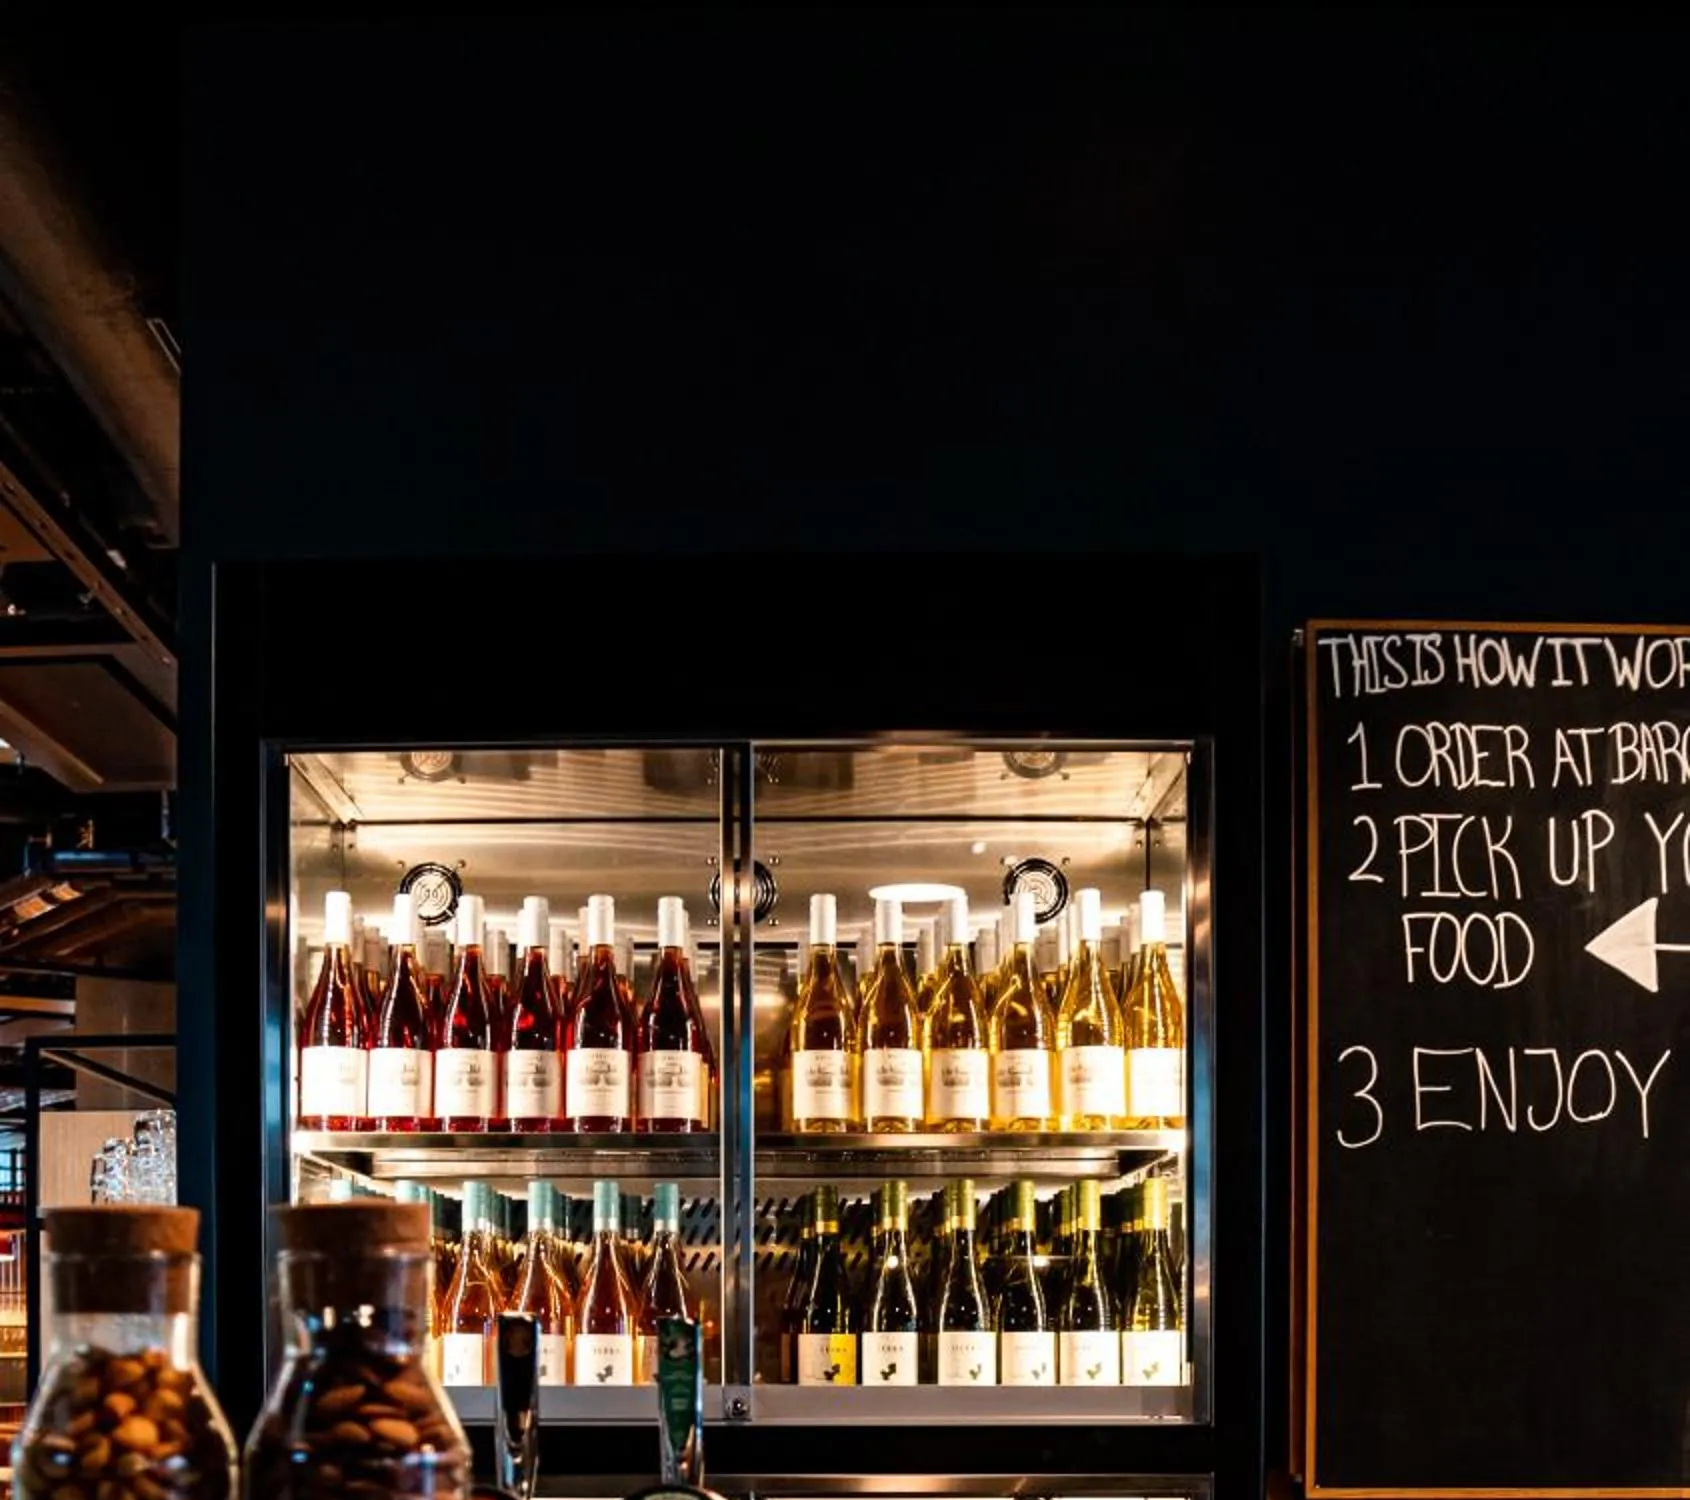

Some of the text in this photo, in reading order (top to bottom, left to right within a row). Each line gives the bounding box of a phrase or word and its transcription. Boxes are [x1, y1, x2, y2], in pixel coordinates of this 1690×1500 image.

[1317, 633, 1409, 698] THIS
[1405, 632, 1446, 687] IS
[1453, 633, 1545, 689] HOW
[1545, 637, 1603, 687] IT
[1347, 720, 1690, 791] 1 ORDER AT BAR
[1347, 809, 1690, 901] 2 PICK UP Y
[1402, 911, 1535, 990] FOOD
[1336, 1044, 1671, 1148] 3 ENJOY
